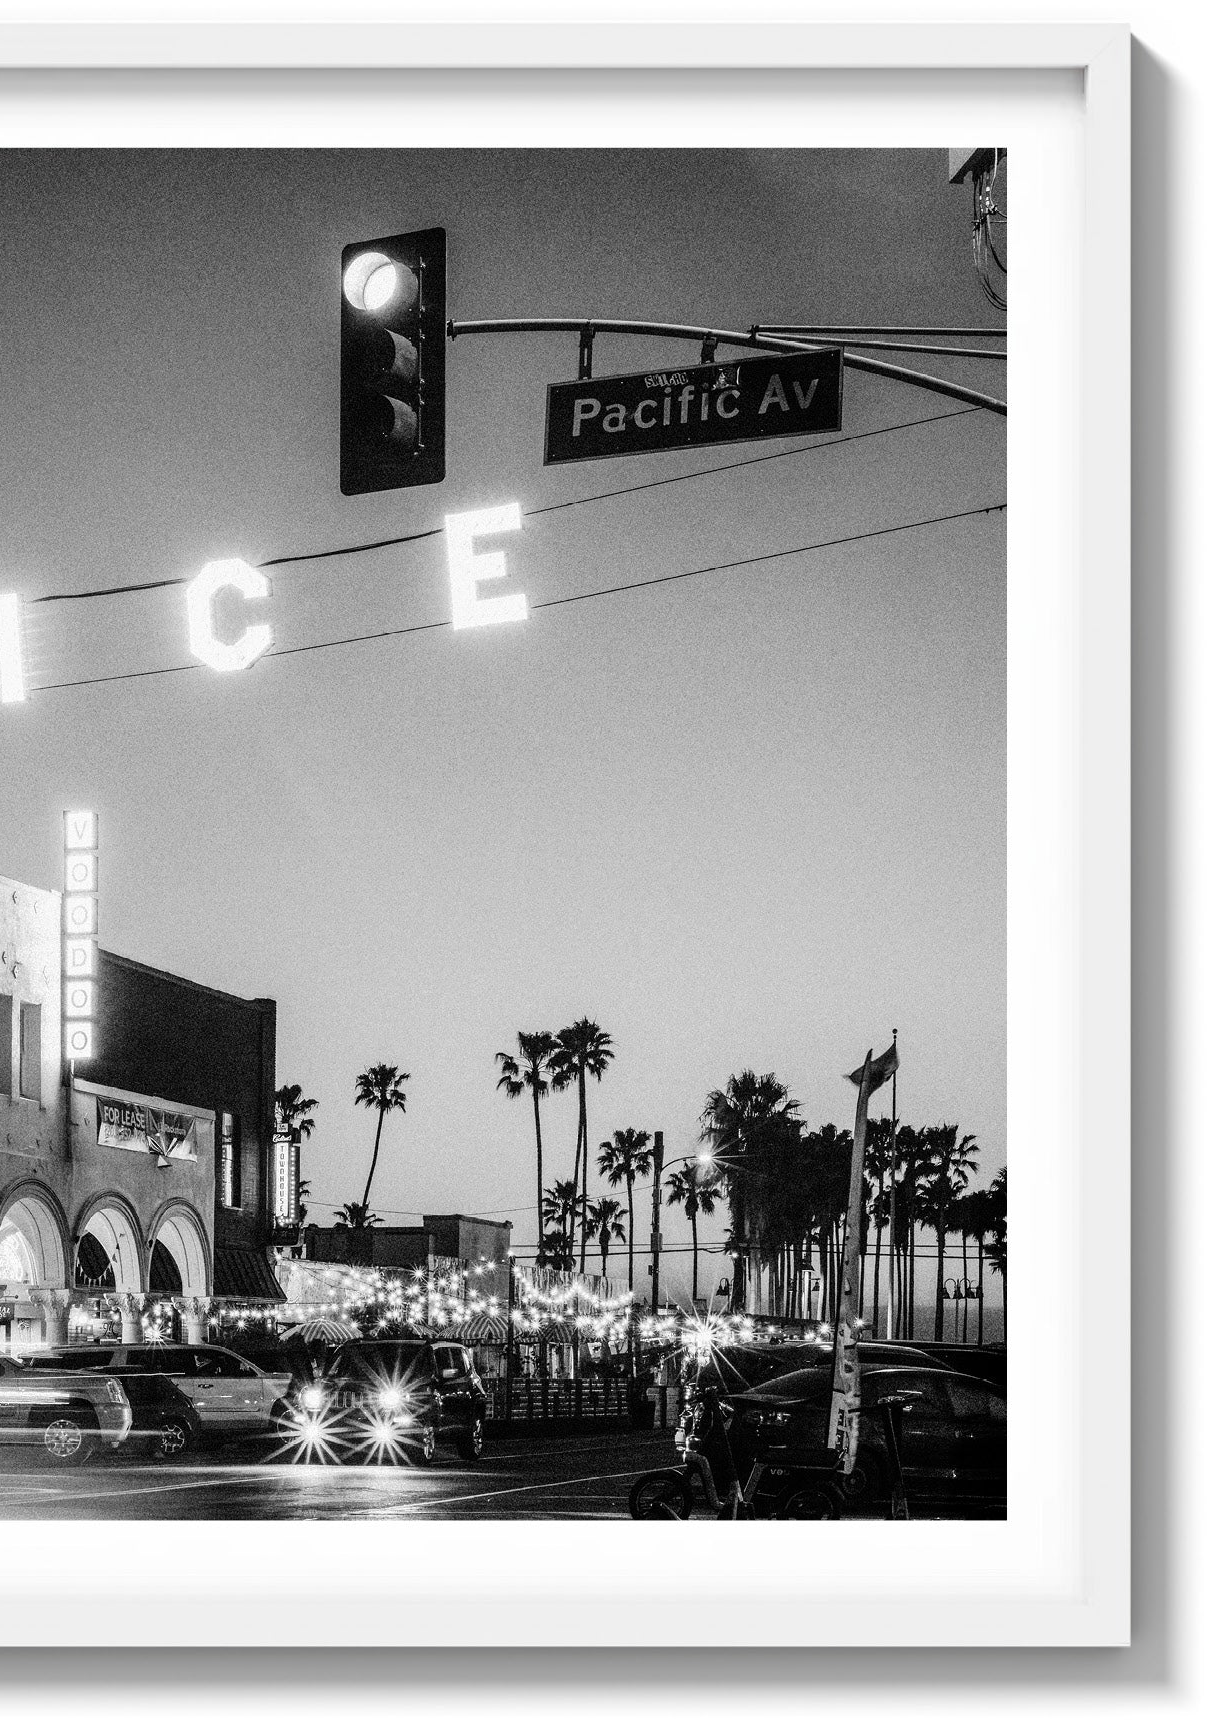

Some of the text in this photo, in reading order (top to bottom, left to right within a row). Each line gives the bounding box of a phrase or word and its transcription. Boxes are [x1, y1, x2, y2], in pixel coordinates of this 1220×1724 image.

[572, 373, 820, 437] Pacific Av
[71, 820, 89, 1051] VOODOO
[103, 1105, 146, 1129] FOR LEASE
